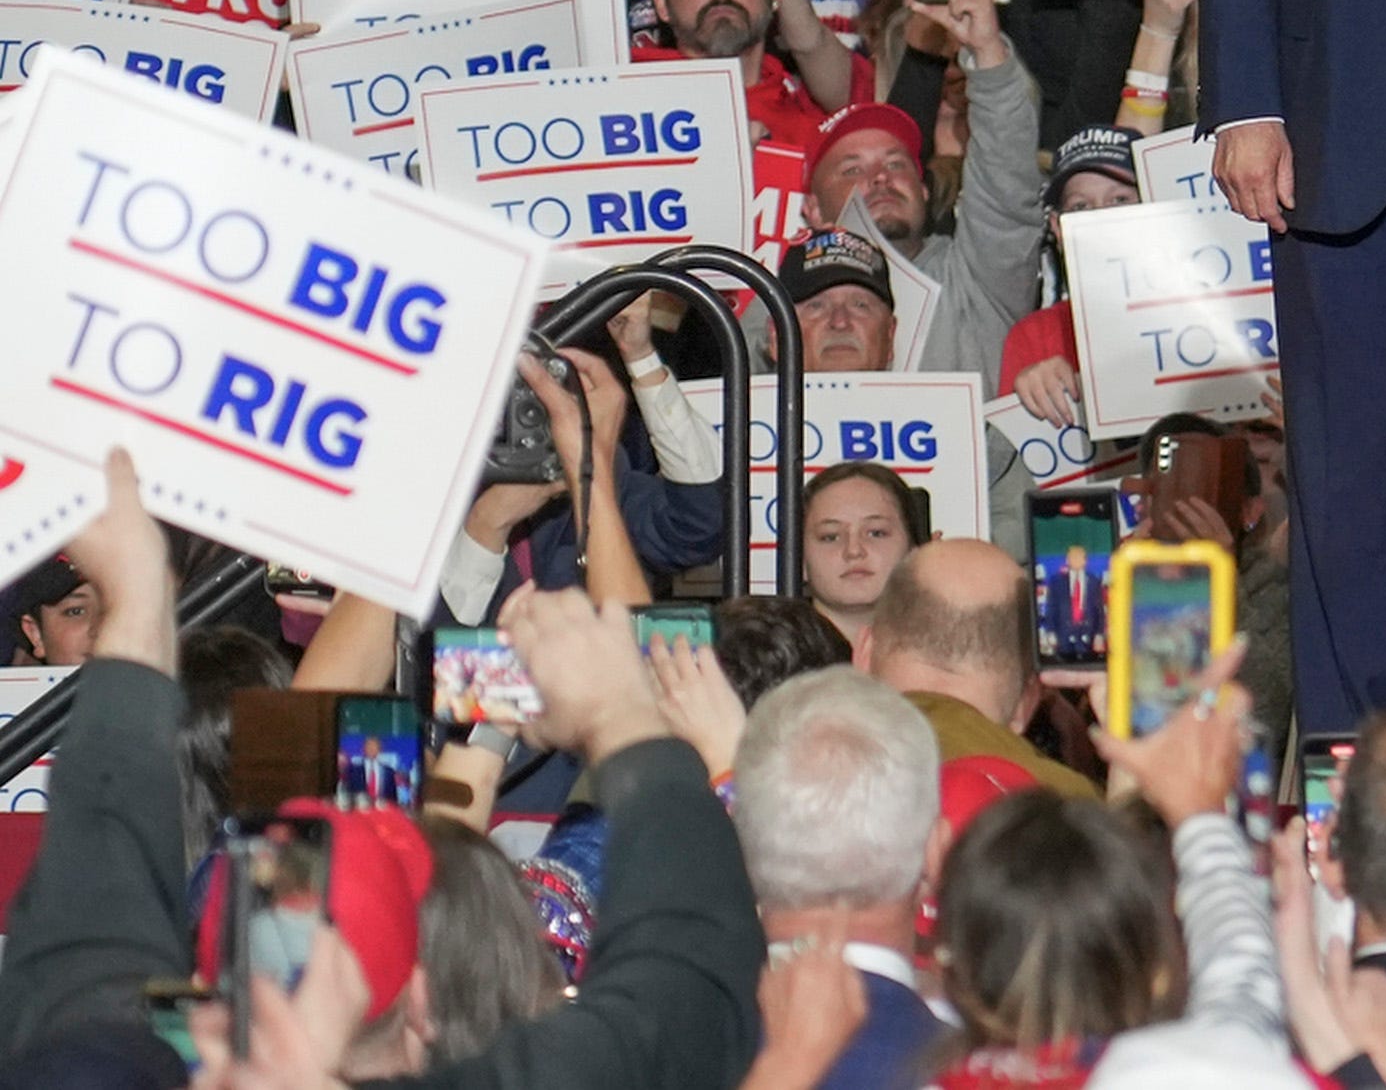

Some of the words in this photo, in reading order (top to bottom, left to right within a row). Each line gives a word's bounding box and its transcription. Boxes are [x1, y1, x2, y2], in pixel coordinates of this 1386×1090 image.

[125, 51, 225, 104] BIG
[458, 117, 585, 169] TOO
[600, 109, 702, 156] BIG
[1058, 129, 1129, 157] TRUMP
[492, 196, 572, 239] TO
[587, 188, 688, 235] RIG
[77, 149, 270, 285] TOO
[285, 237, 447, 357] BIG
[1107, 244, 1232, 298] TO
[1140, 324, 1217, 372] TO
[66, 291, 183, 398] TO
[200, 351, 370, 473] RIG
[839, 420, 938, 462] BIG
[1020, 424, 1097, 478] OO
